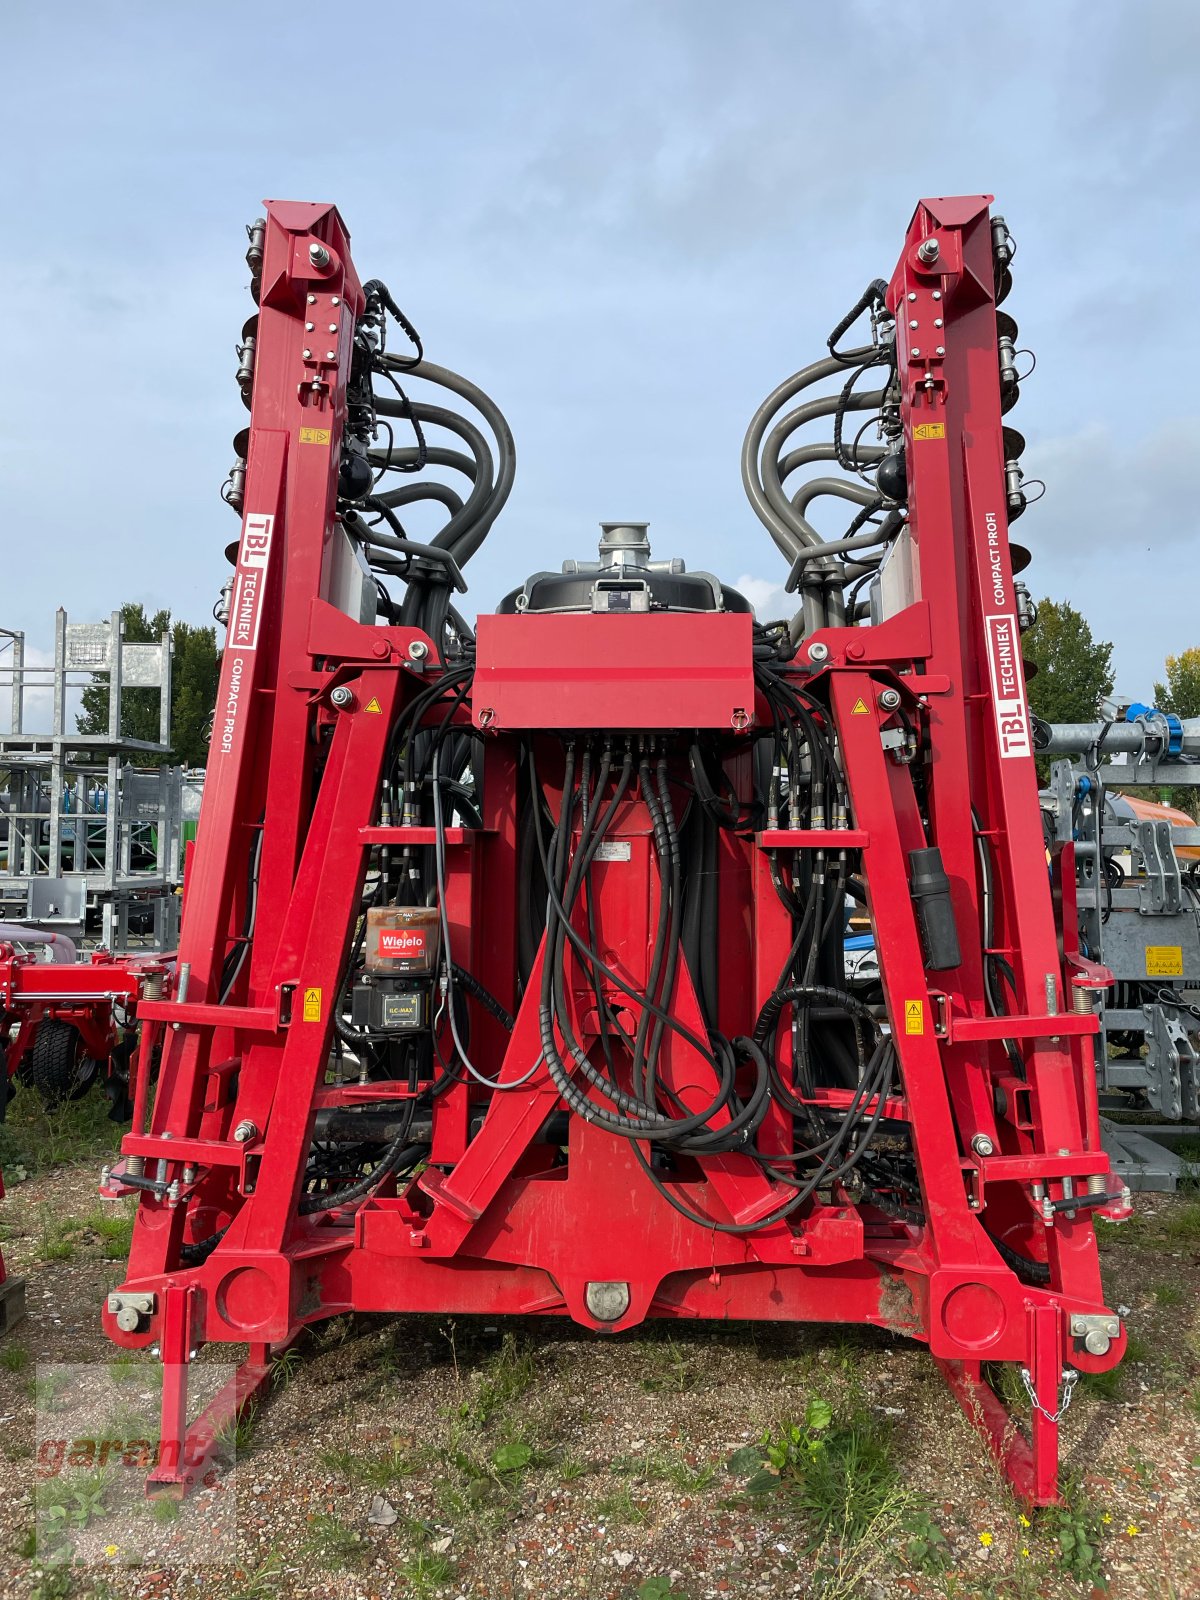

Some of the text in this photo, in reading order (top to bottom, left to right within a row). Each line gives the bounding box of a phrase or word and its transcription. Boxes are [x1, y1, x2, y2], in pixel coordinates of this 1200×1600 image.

[236, 518, 271, 641] TBL TECHNIEK
[985, 512, 1006, 606] COMPACT PROFI
[220, 657, 244, 754] COMPACT PROFI
[995, 622, 1026, 753] TBL TECHNIEK
[382, 935, 423, 949] Wiejelo
